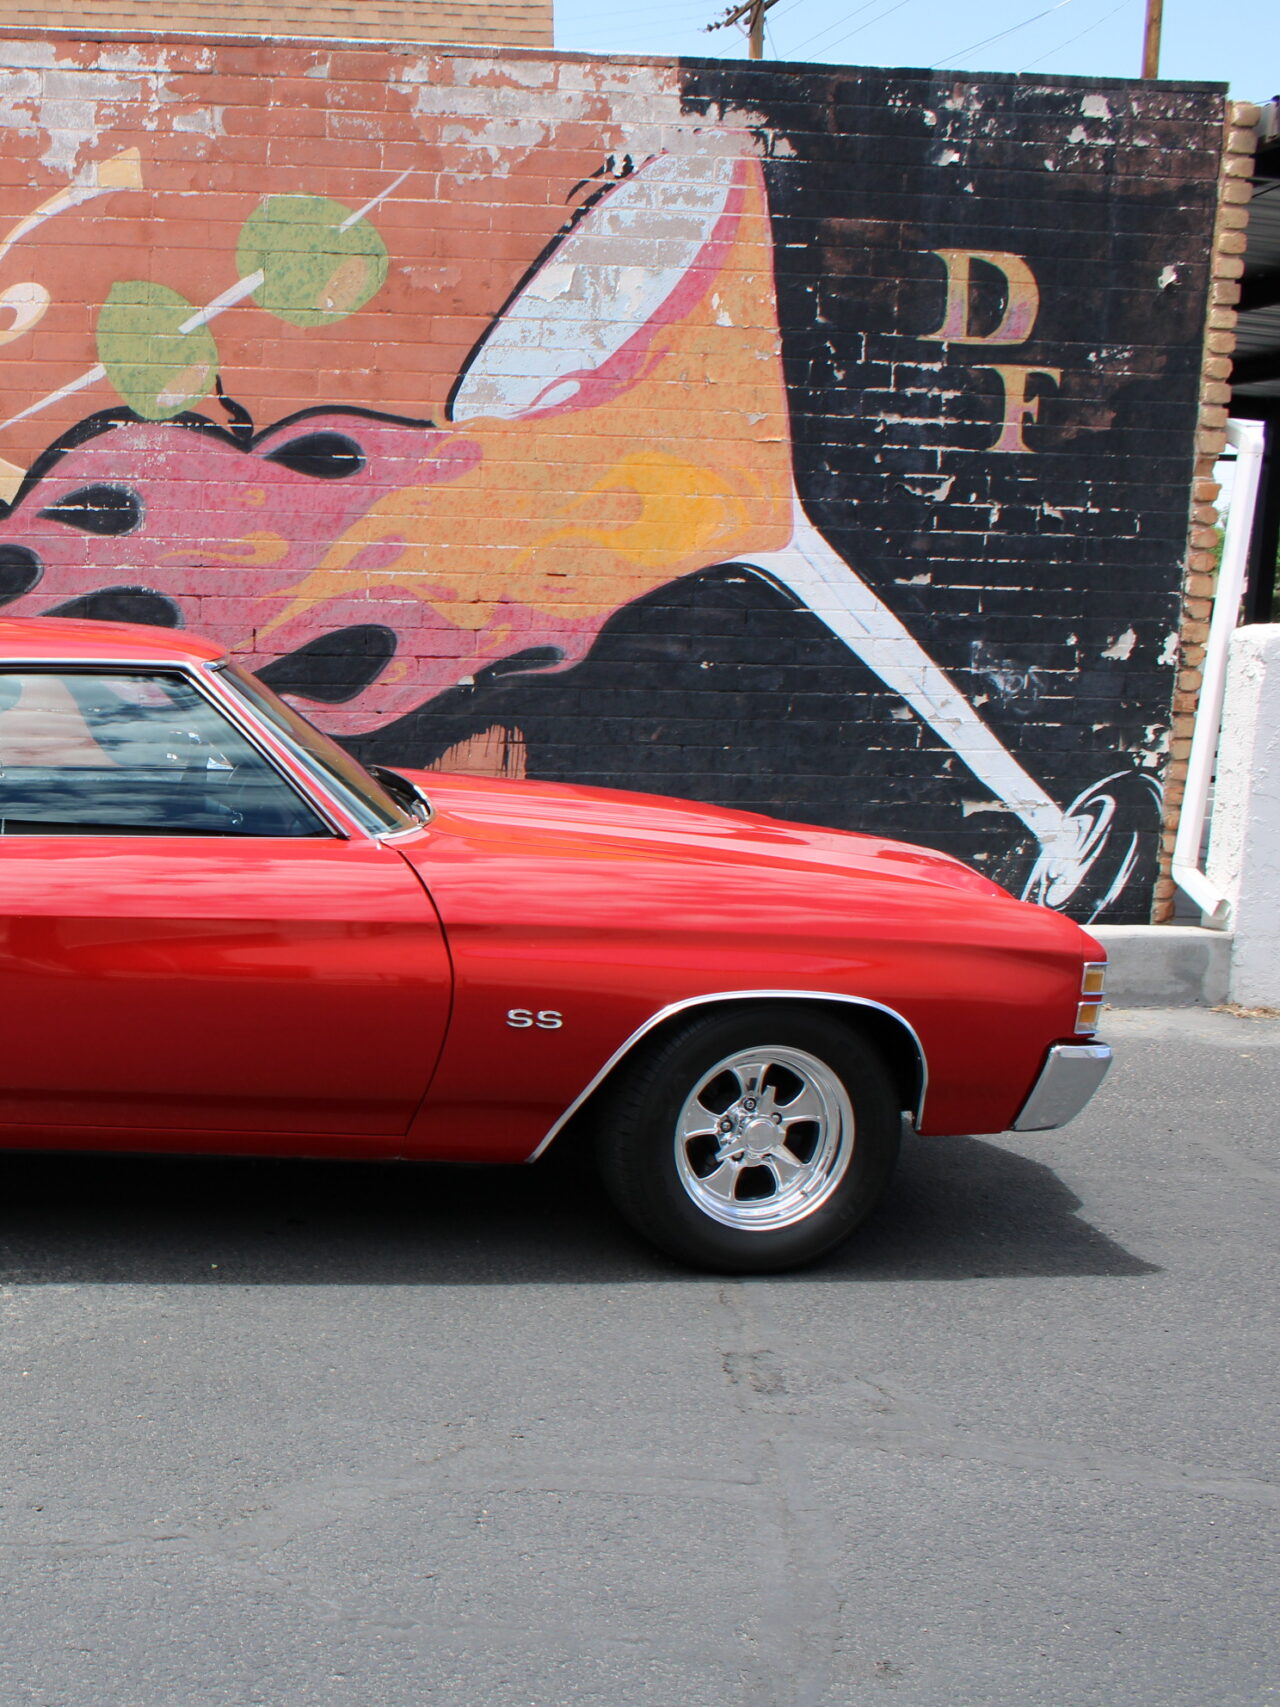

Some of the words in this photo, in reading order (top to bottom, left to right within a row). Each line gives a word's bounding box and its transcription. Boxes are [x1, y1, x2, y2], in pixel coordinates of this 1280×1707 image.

[917, 248, 1040, 345] D
[987, 364, 1063, 453] F
[506, 1008, 563, 1029] SS
